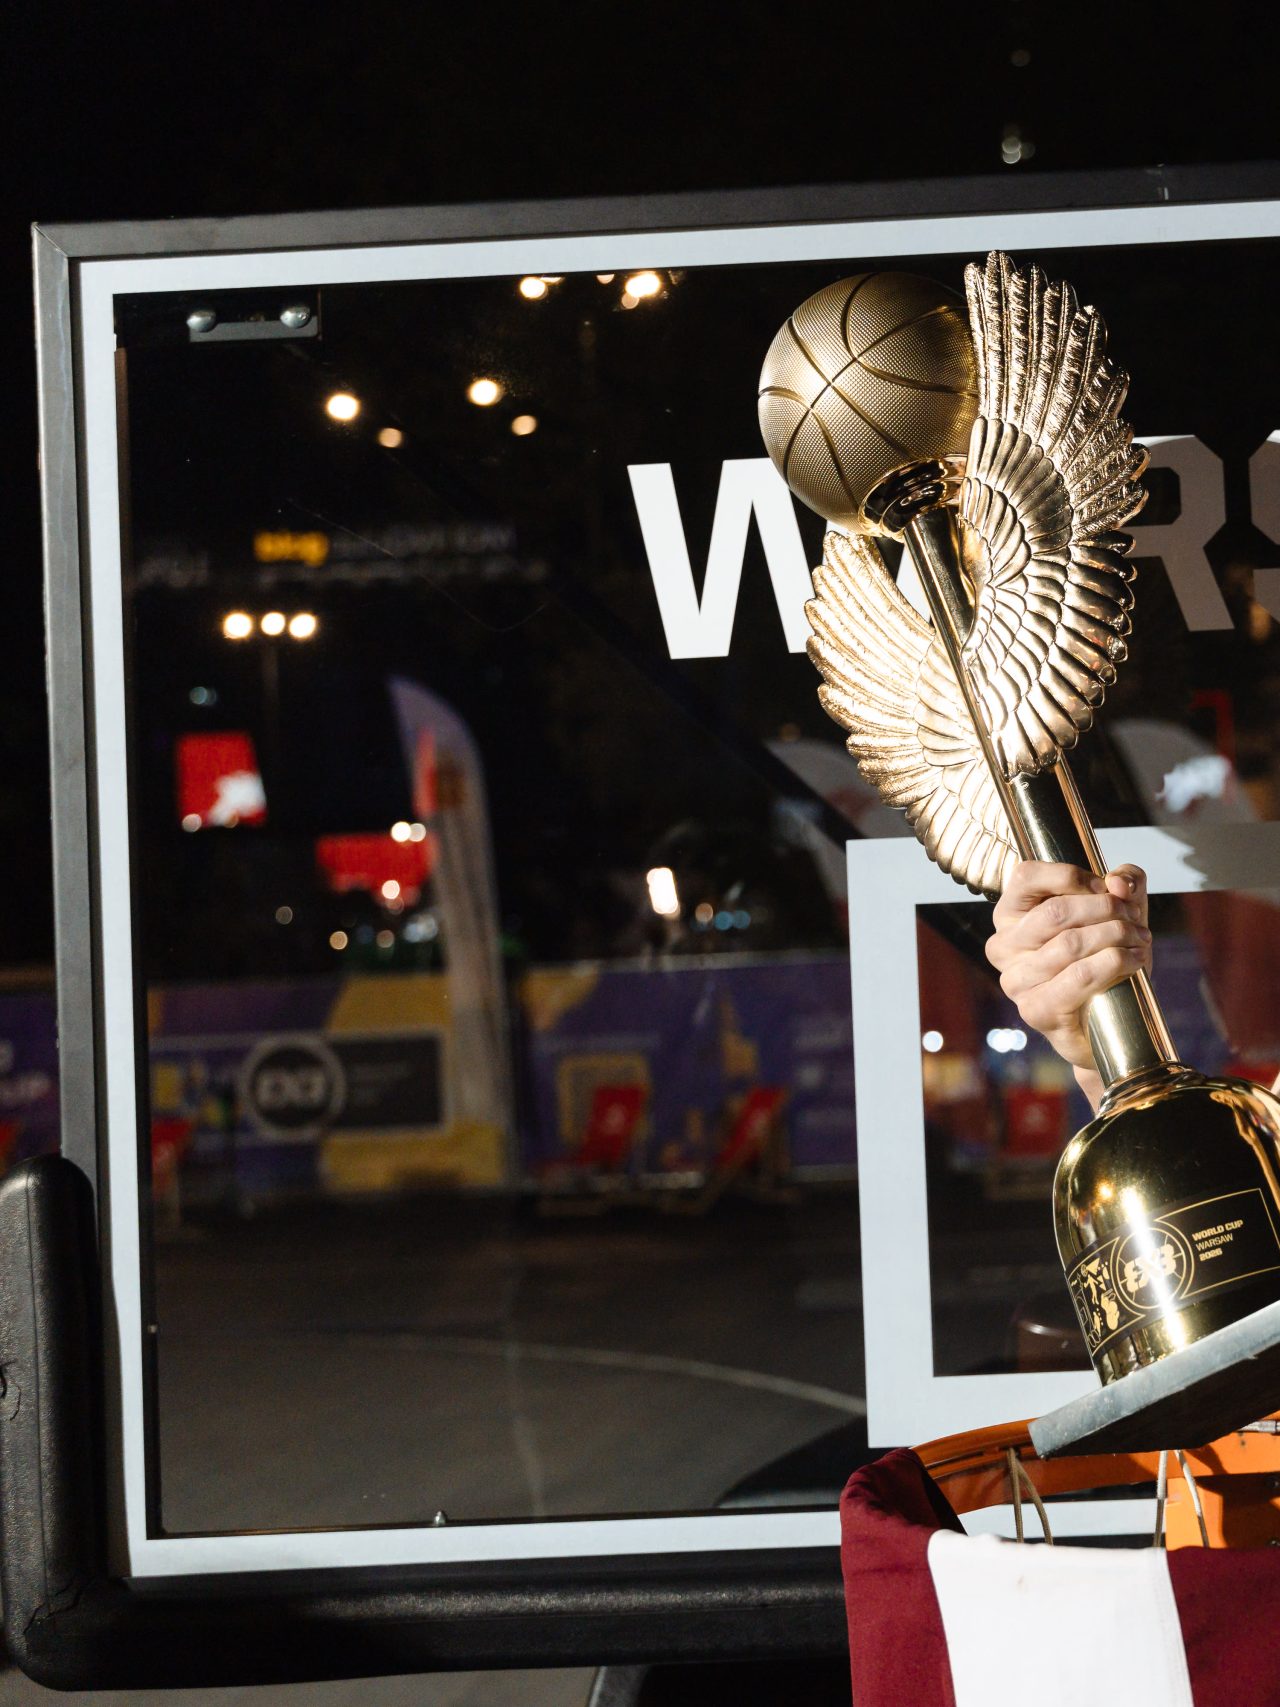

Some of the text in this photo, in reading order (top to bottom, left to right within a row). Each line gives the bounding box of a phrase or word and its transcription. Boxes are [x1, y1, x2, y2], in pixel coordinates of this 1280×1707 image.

[1192, 1219, 1244, 1242] WORLD CUP
[1195, 1232, 1234, 1252] WARSAW
